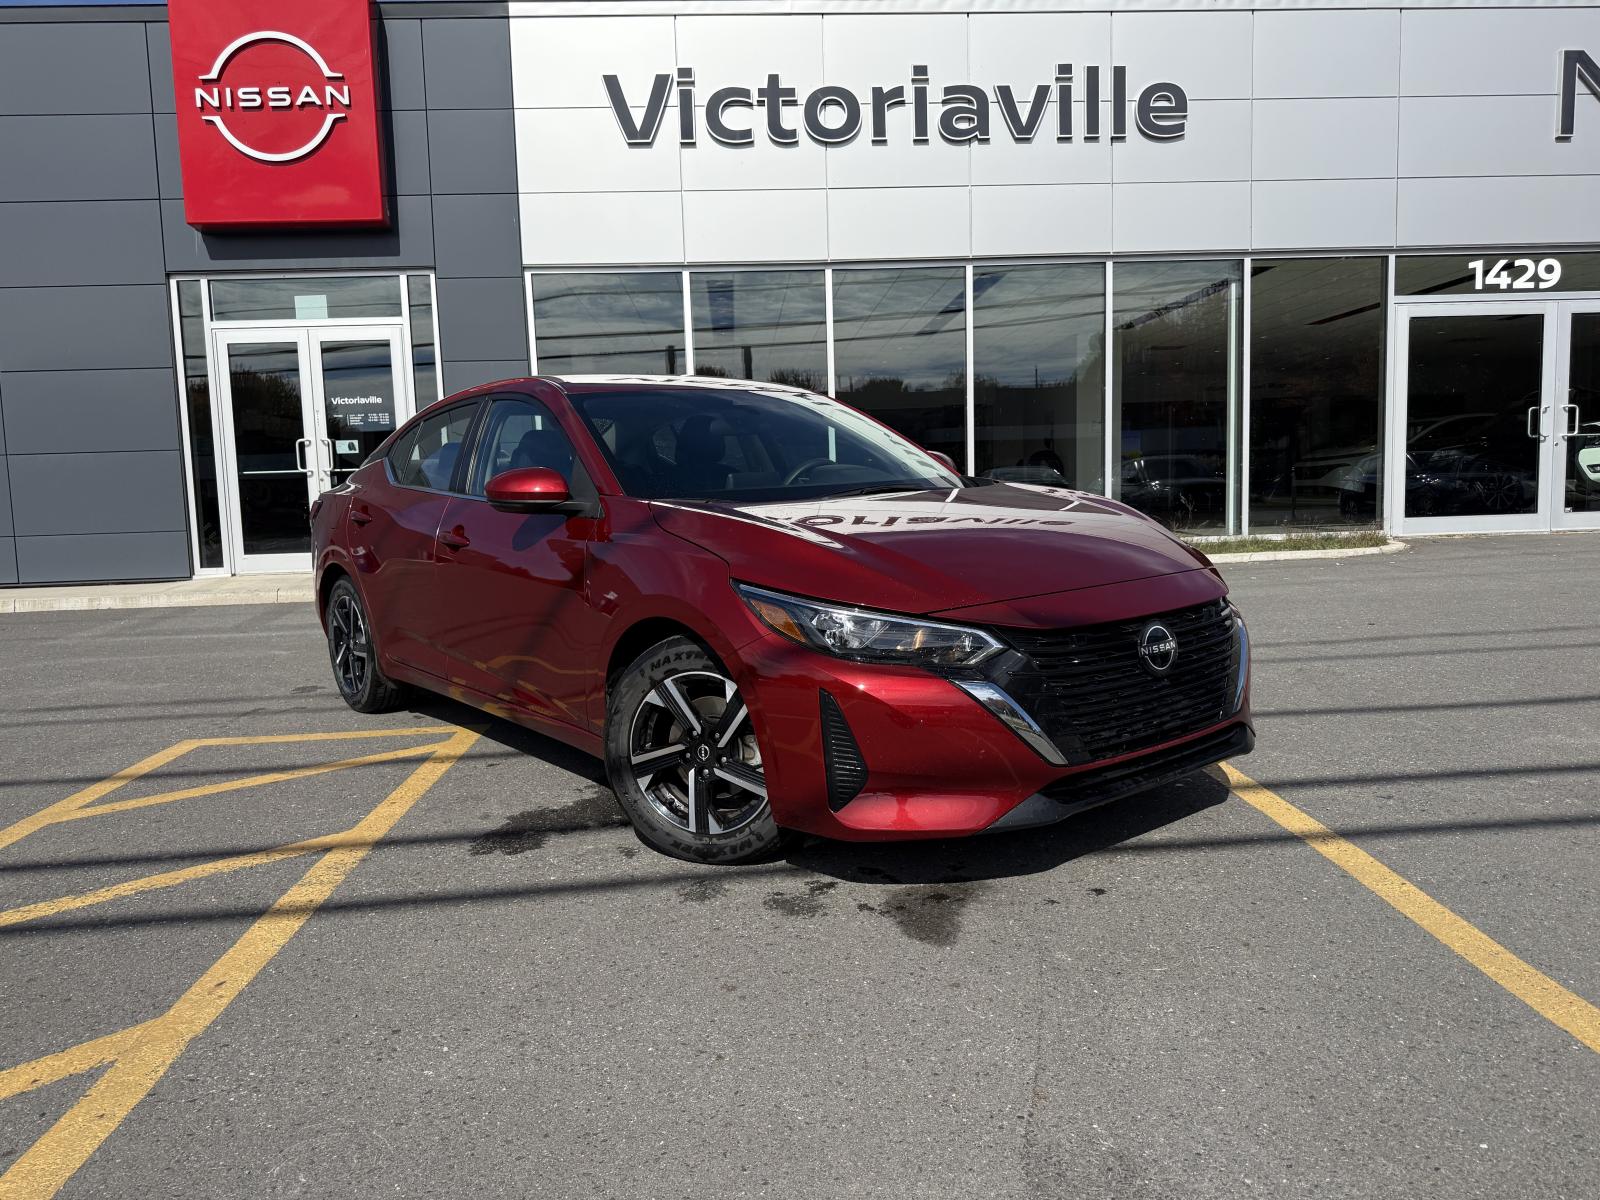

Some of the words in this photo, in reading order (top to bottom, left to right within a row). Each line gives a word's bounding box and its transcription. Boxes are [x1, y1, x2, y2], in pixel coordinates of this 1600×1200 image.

[194, 85, 350, 108] NISSAN
[602, 64, 1188, 145] Victoriaville
[1468, 258, 1562, 290] 1429
[331, 396, 382, 405] Victoriaville
[1140, 640, 1176, 656] NISSAN
